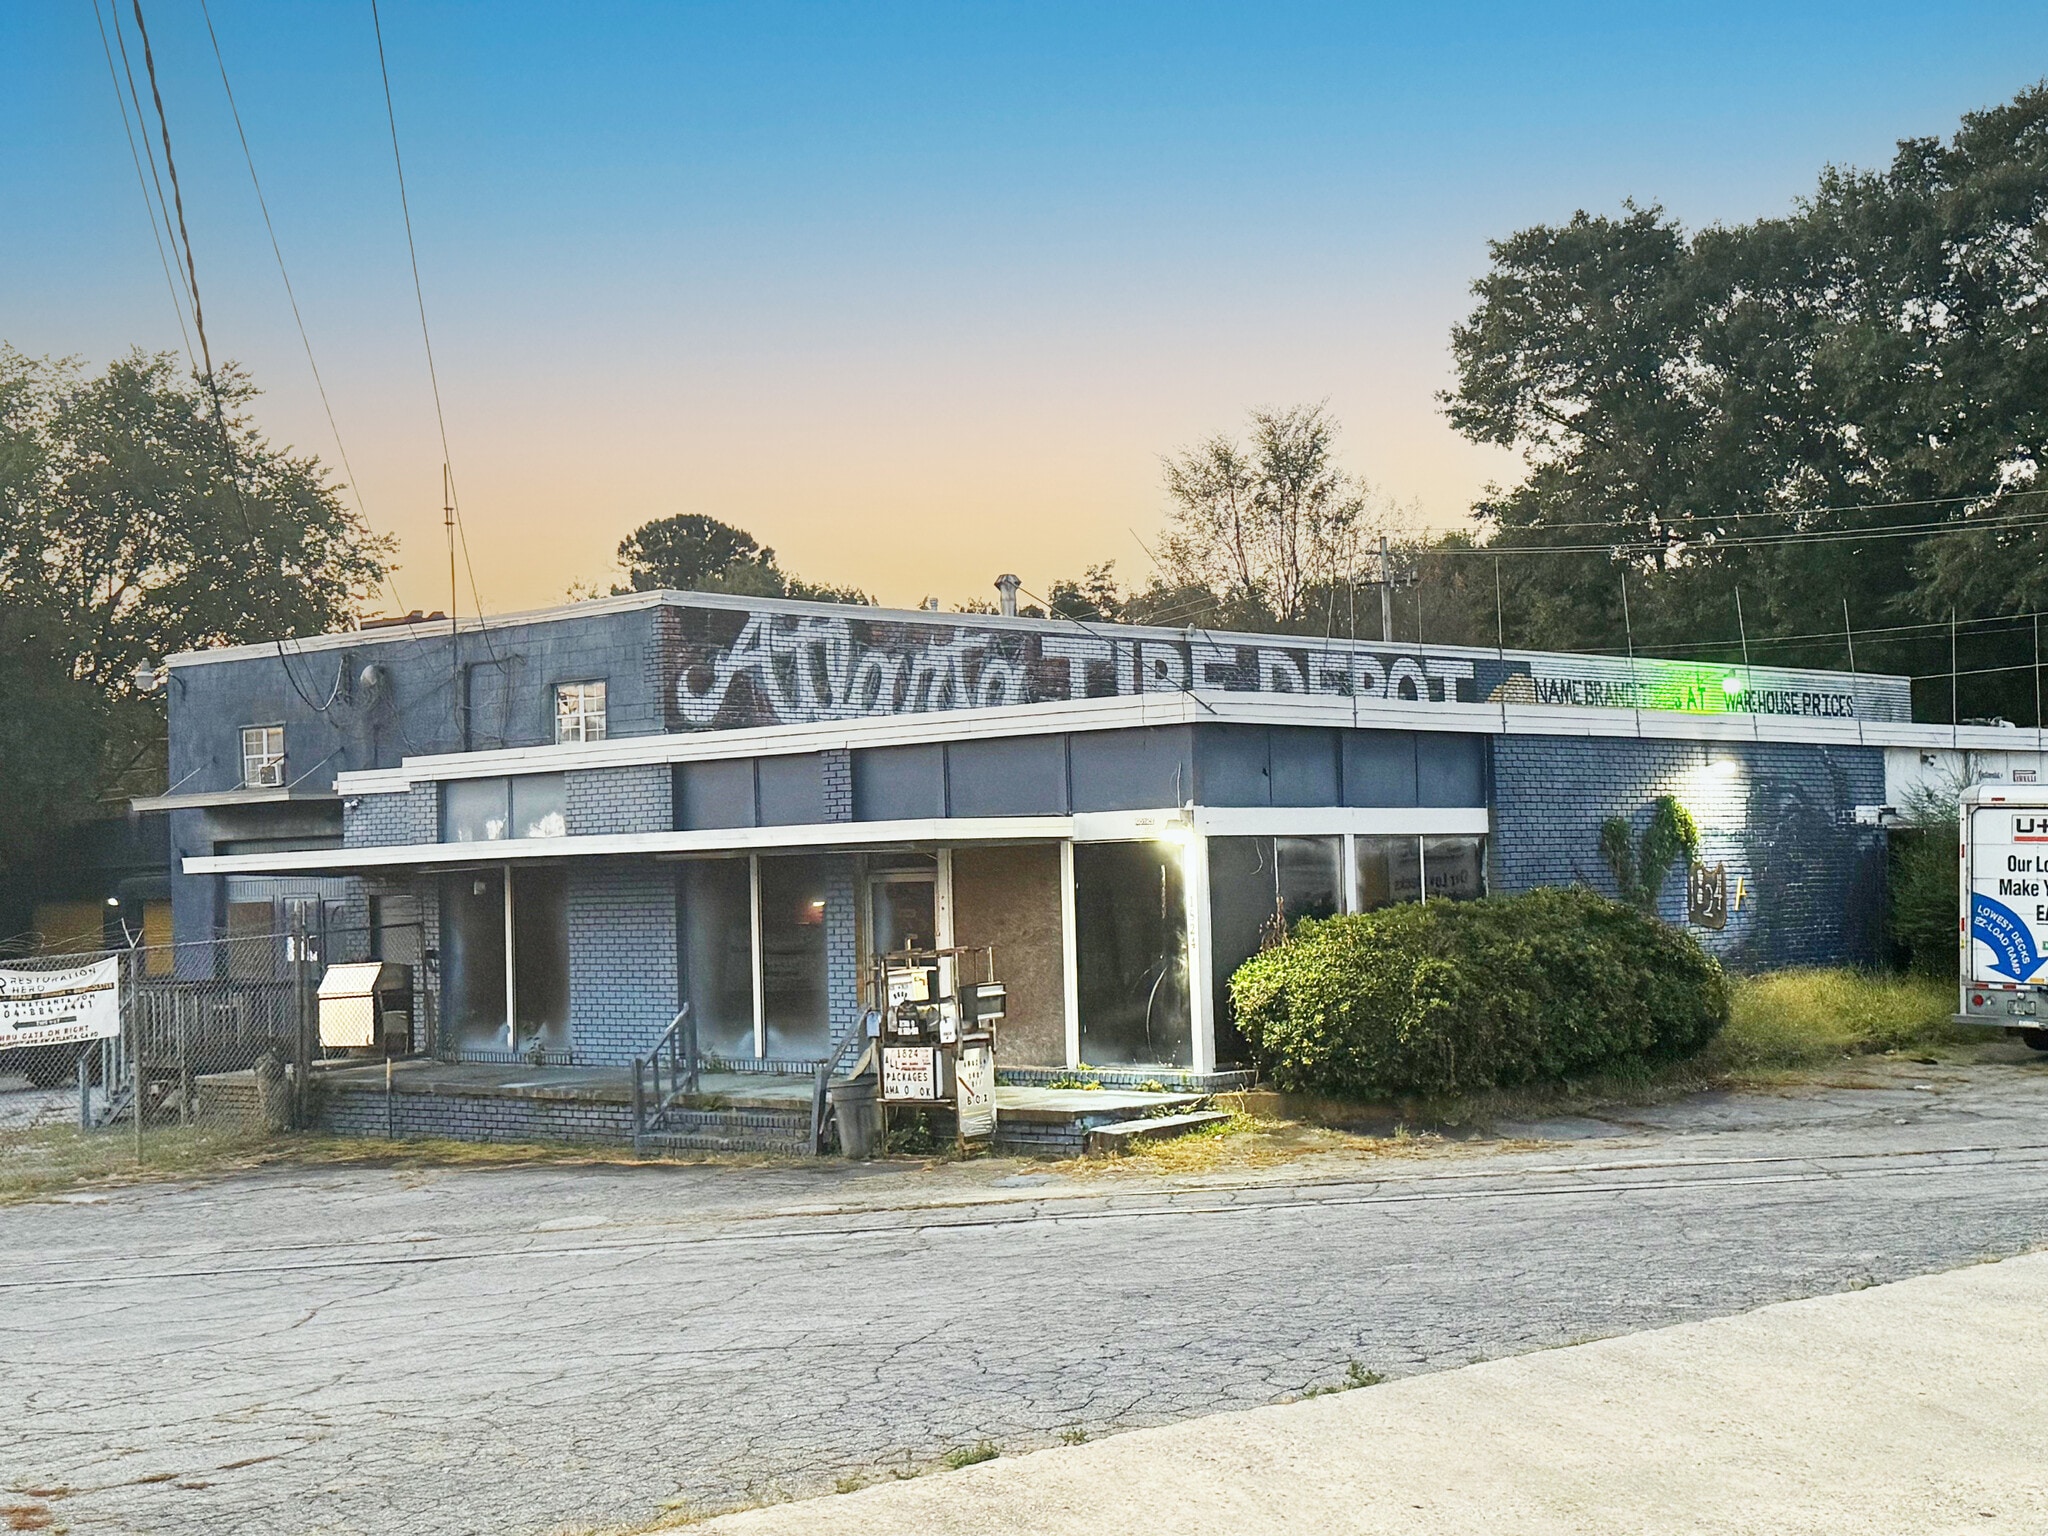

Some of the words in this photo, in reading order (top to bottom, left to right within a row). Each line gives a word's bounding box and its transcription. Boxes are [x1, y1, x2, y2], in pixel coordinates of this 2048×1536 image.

[1041, 635, 1238, 699] TIRE
[1257, 649, 1475, 702] DEPOT
[1534, 677, 1581, 704] NAME
[1686, 687, 1706, 709] AT
[1724, 689, 1800, 715] WAREHOUSE
[1803, 692, 1854, 717] PRICES
[2007, 855, 2032, 873] Our
[1690, 869, 1723, 917] 1824
[1999, 879, 2039, 896] Make
[1974, 916, 2010, 946] EZ-LOAD
[2006, 946, 2021, 975] RAMP
[1977, 904, 2013, 931] LOWEST
[2011, 927, 2030, 964] DECKS
[886, 1072, 928, 1081] PACKAGES
[919, 1087, 932, 1096] OK
